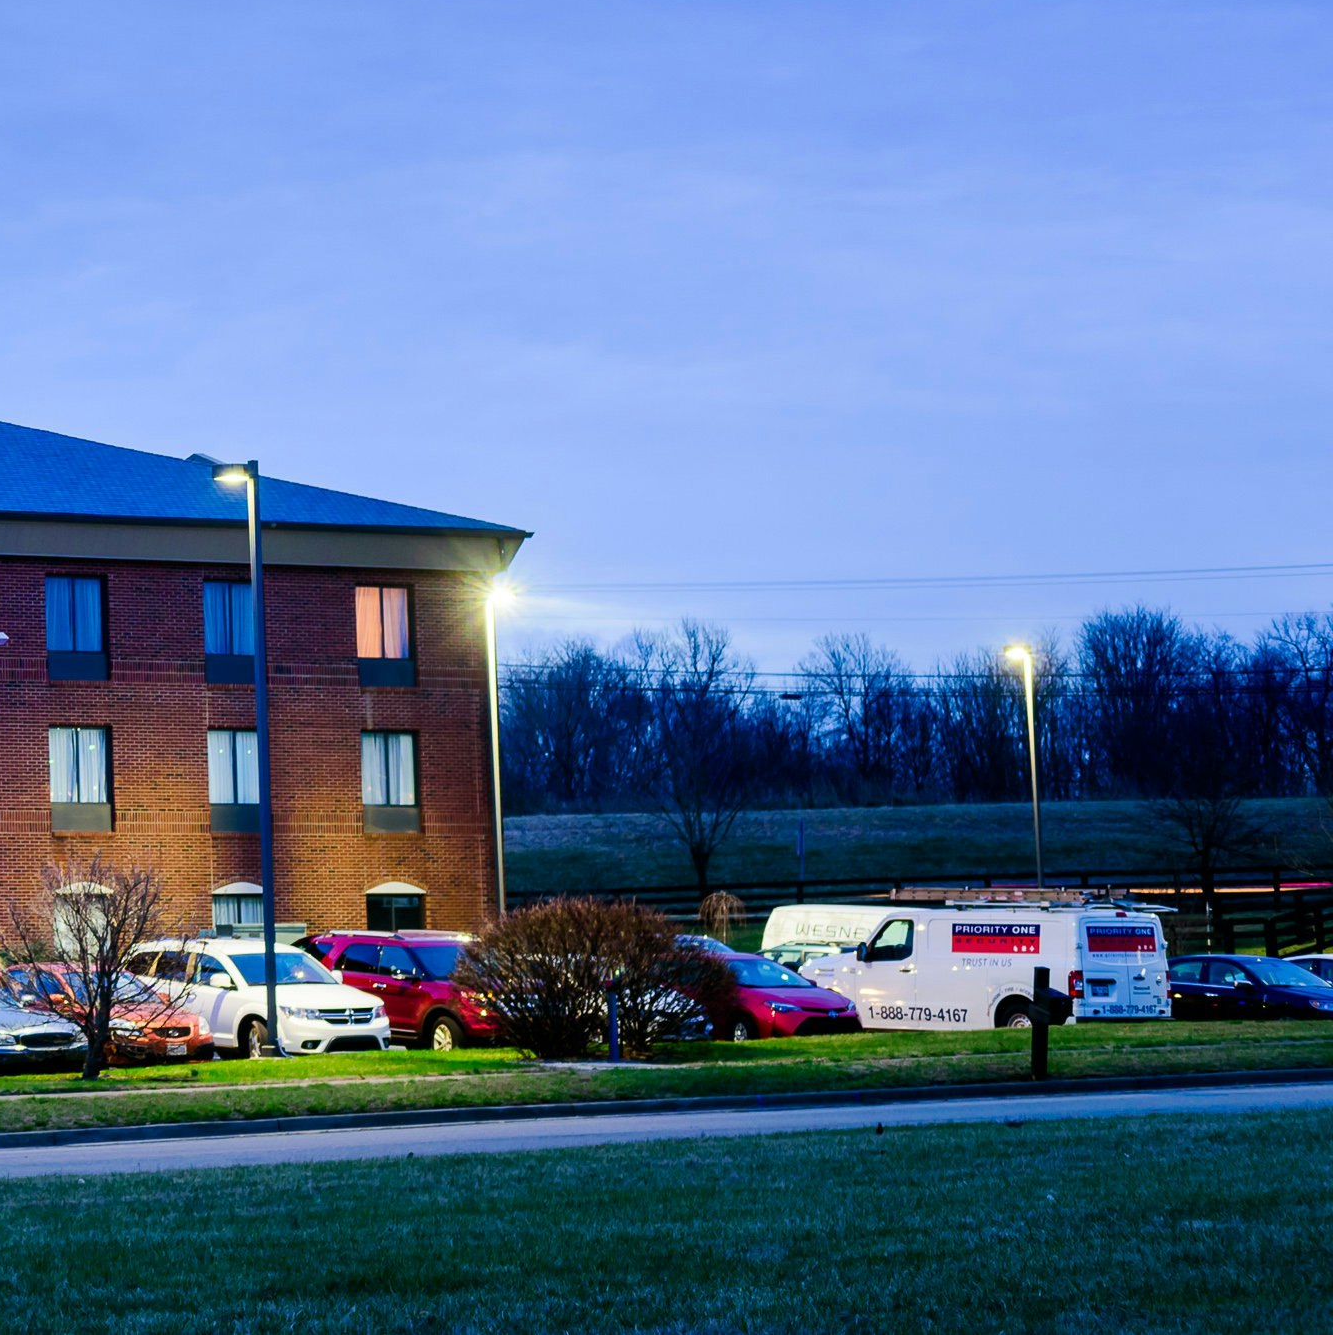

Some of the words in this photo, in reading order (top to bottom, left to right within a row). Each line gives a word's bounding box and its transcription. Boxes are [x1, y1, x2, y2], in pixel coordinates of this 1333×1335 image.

[955, 925, 1008, 934] PRIORITY
[1012, 925, 1036, 934] ONE
[962, 958, 988, 967] TRUST
[989, 958, 999, 967] IN
[1001, 958, 1013, 967] US
[868, 1006, 968, 1023] 1-888-779-4167
[1101, 1005, 1157, 1015] 1-888-779-4167
